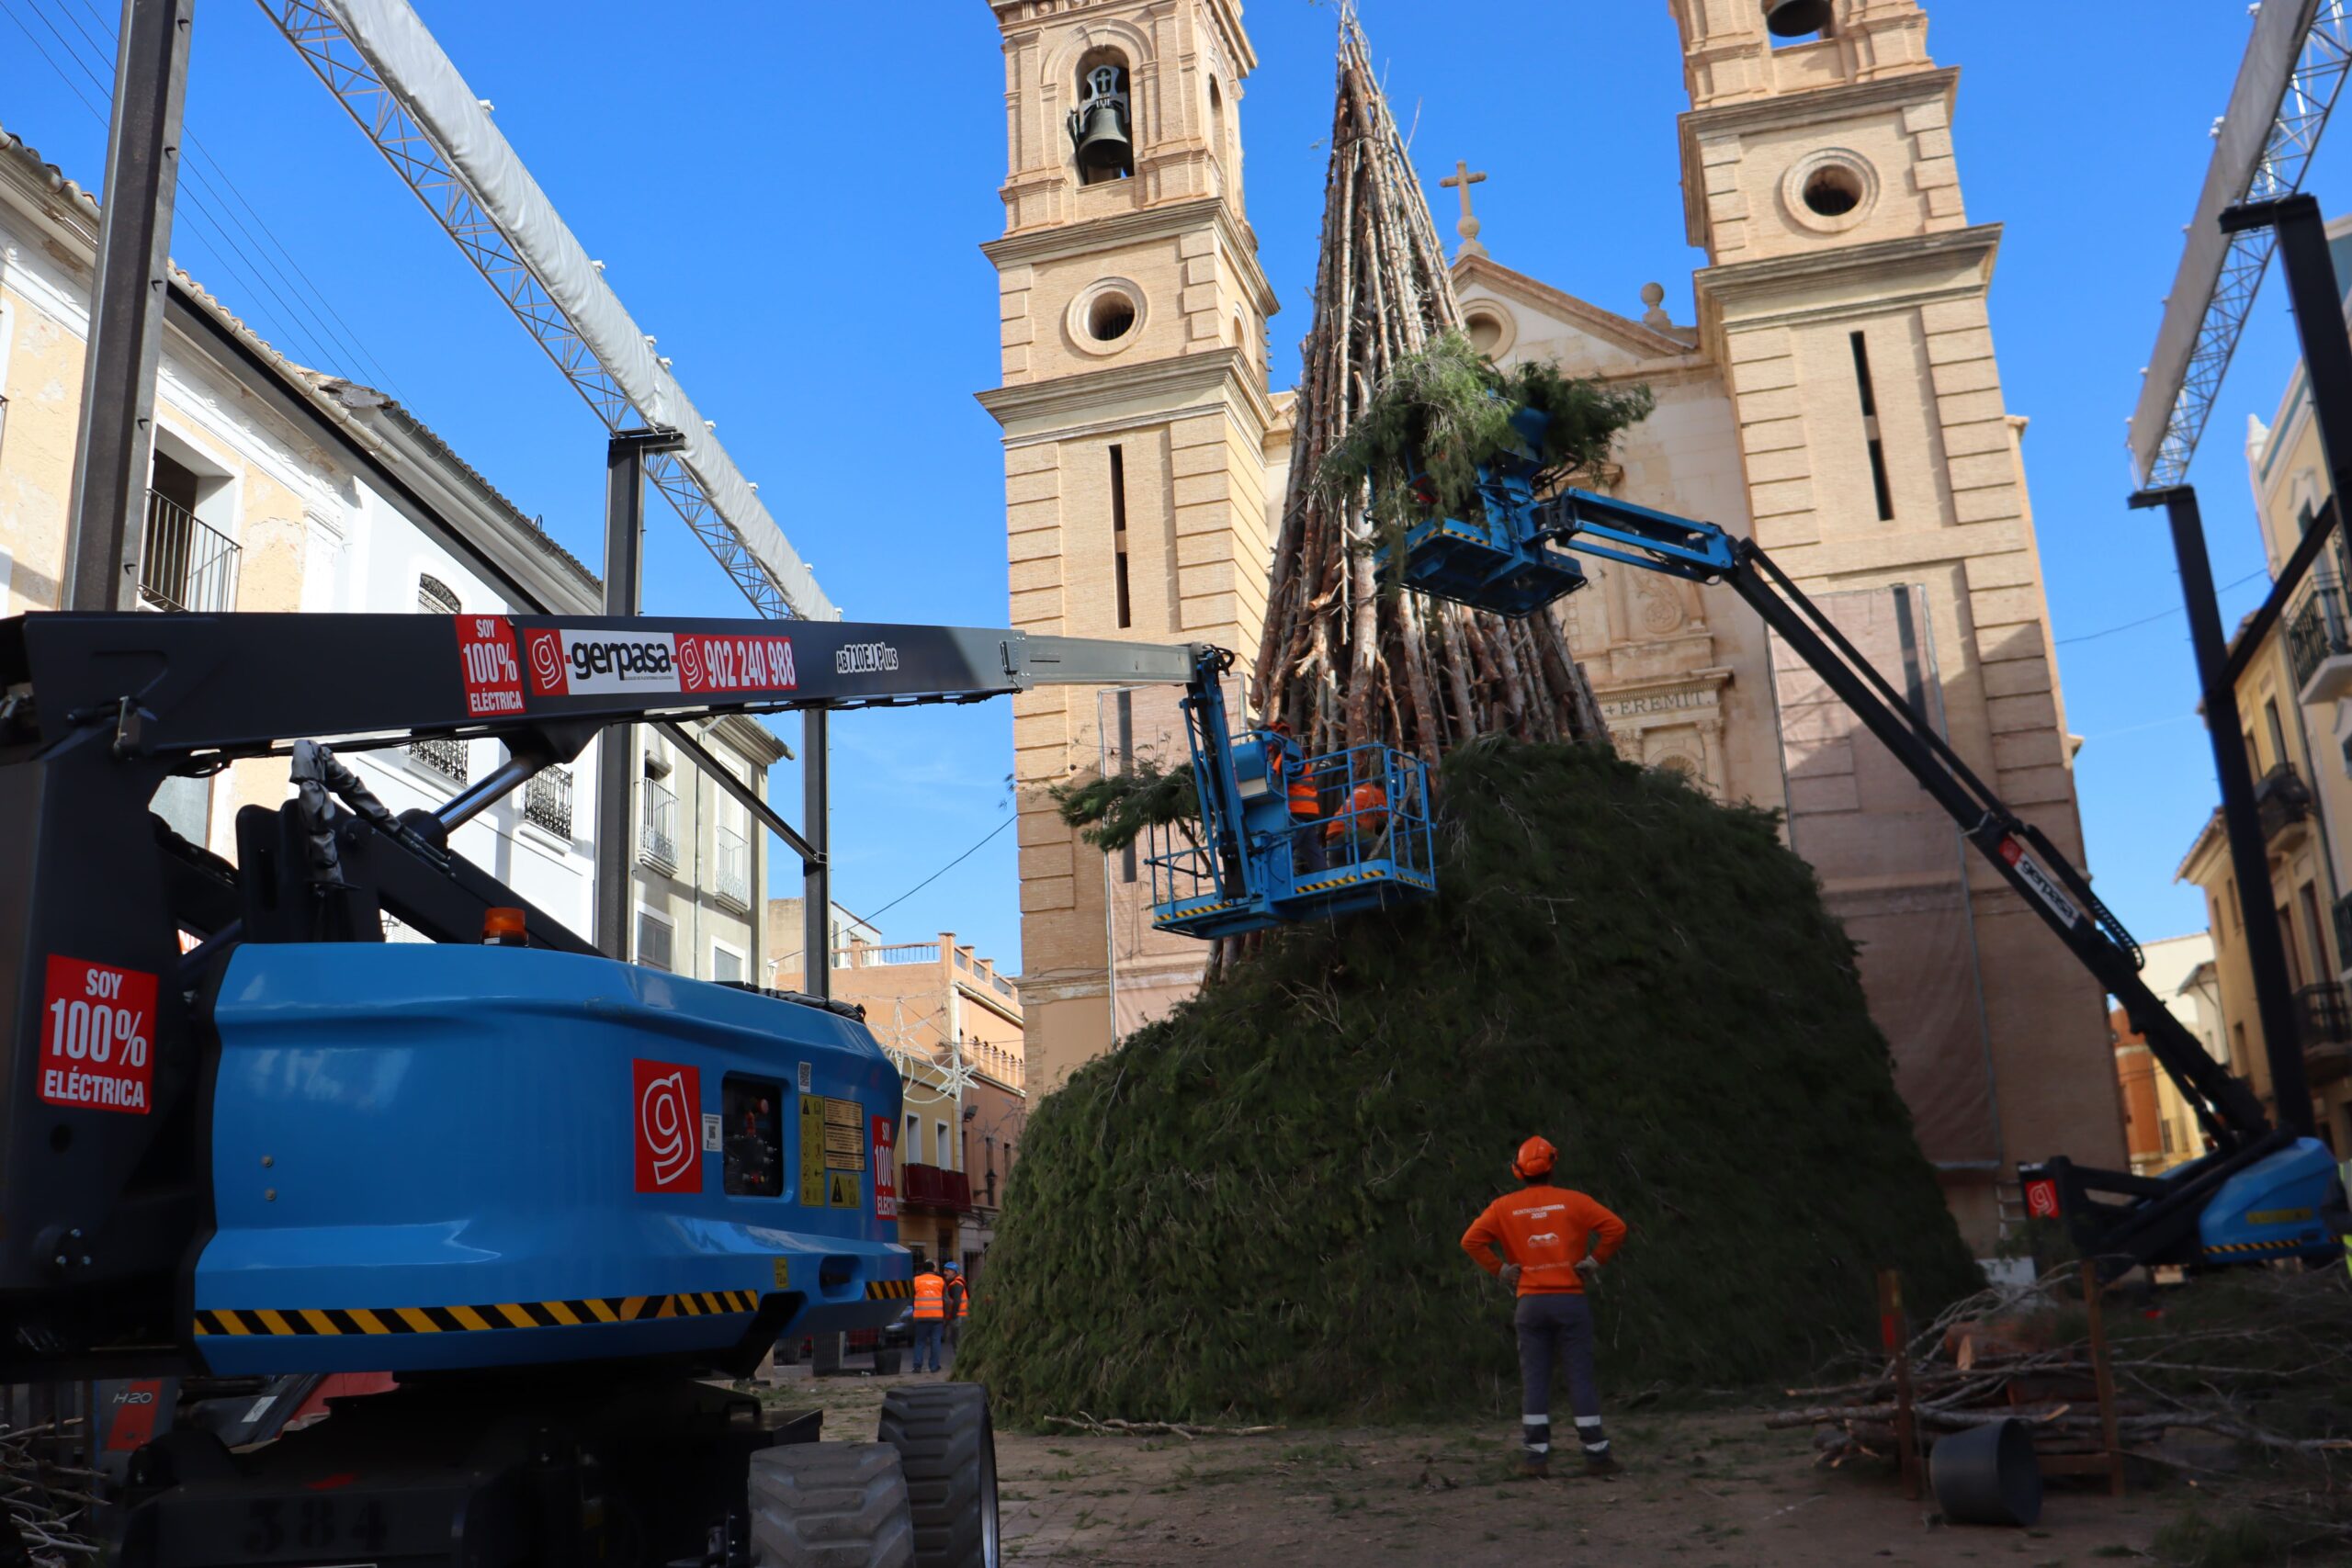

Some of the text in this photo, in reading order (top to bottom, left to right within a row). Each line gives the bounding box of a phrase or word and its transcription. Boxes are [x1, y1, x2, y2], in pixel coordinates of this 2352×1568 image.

[475, 618, 495, 638] SOY
[463, 642, 517, 683] 100%
[571, 641, 672, 681] gerpasa
[704, 640, 737, 688] 902
[737, 640, 767, 687] 240
[767, 640, 796, 686] 988
[876, 641, 899, 671] Plus
[469, 688, 523, 712] ELÉCTRICA
[2021, 861, 2074, 919] gerpasa
[85, 968, 123, 999] SOY
[51, 998, 147, 1067] 100%
[44, 1066, 144, 1108] ELÉCTRICA
